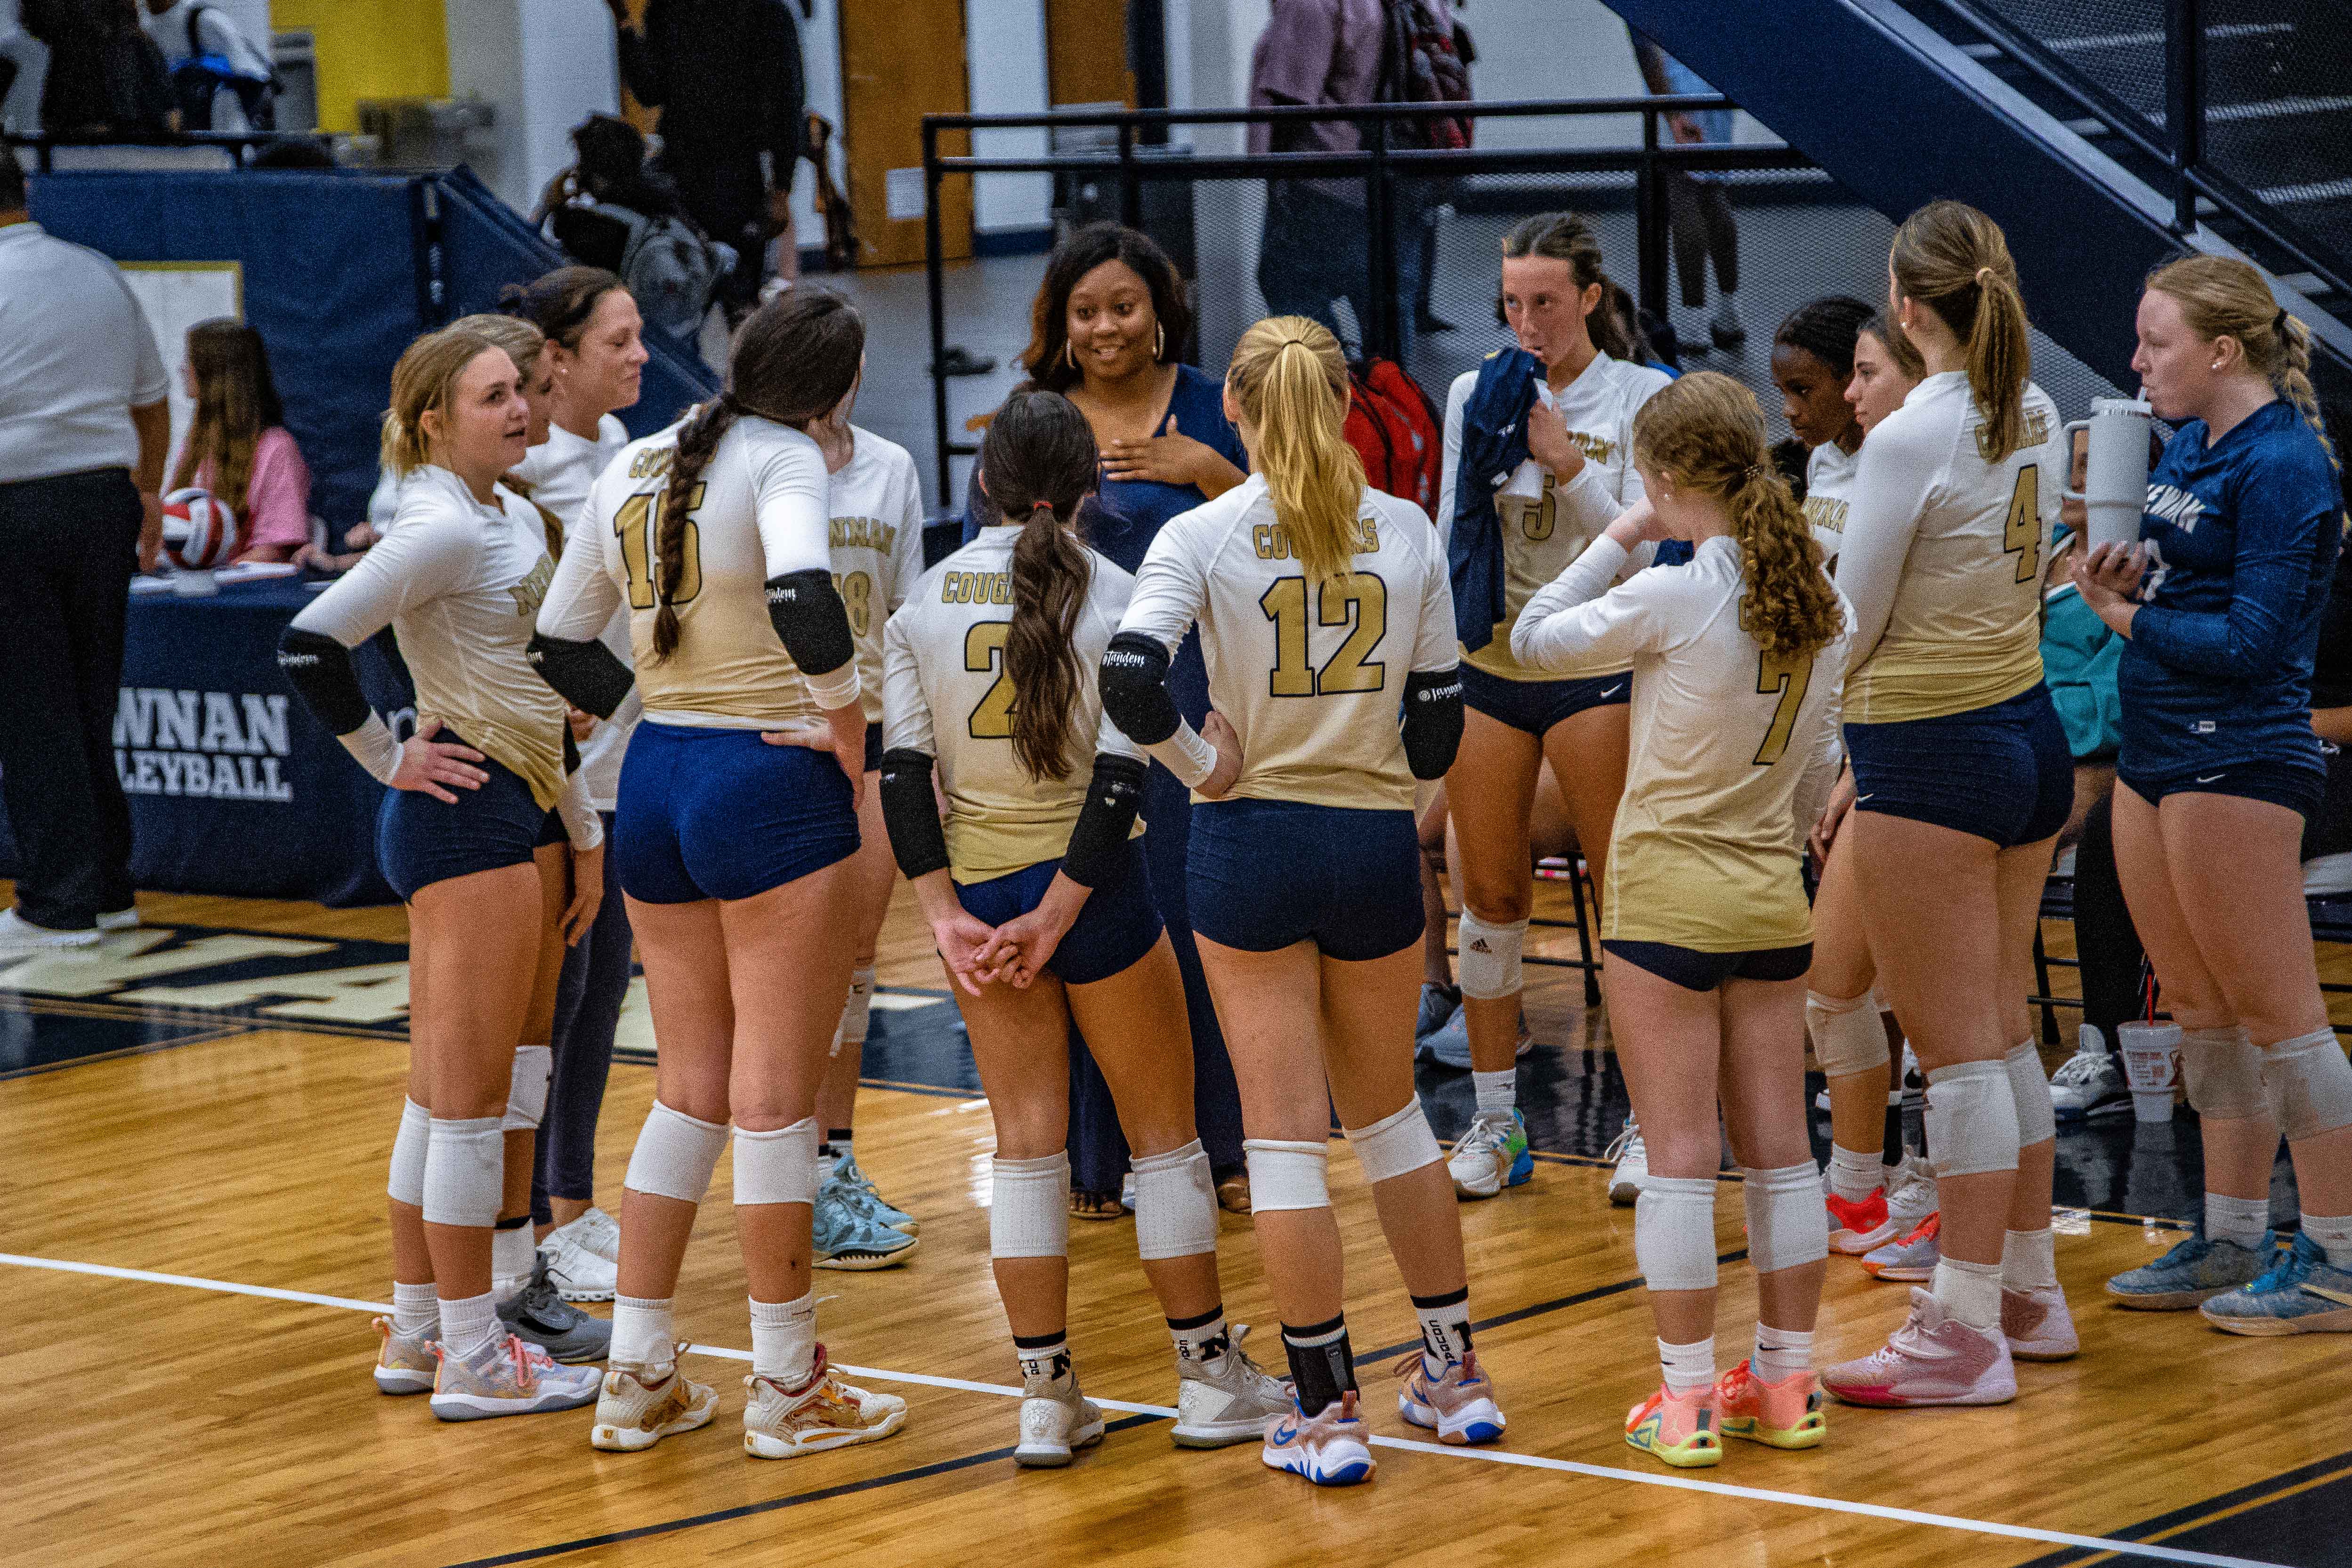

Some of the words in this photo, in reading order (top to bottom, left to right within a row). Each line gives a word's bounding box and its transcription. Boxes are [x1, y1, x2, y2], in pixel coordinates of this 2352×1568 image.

[2004, 464, 2042, 584] 4
[942, 571, 1014, 604] COUG
[1259, 571, 1387, 698] 12
[964, 620, 1017, 739] 2
[1753, 649, 1813, 765] 7
[114, 749, 293, 802] LEYBALL
